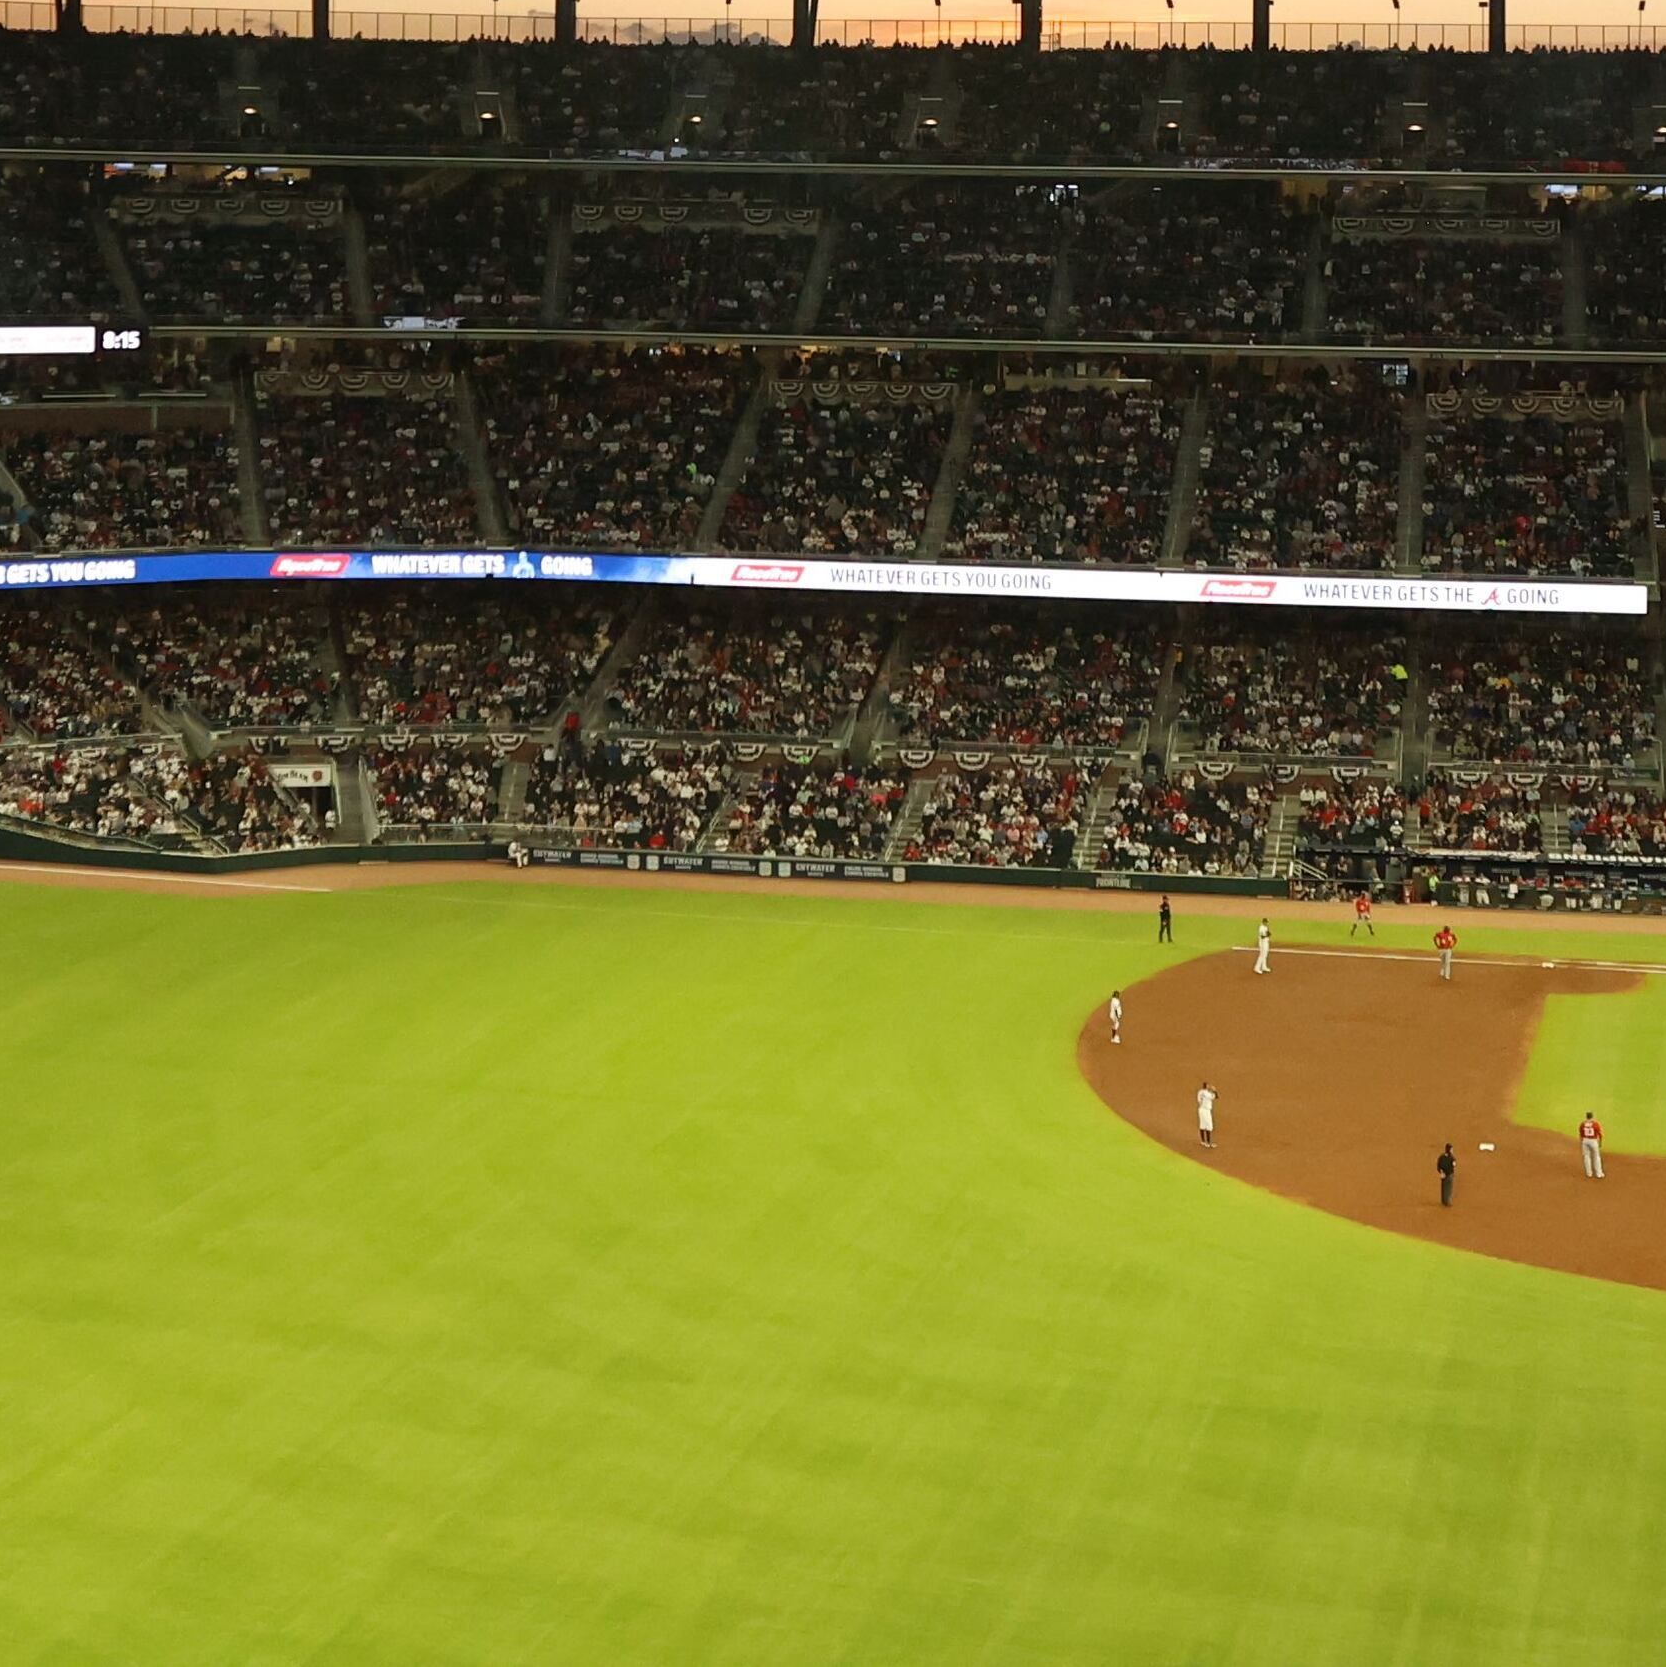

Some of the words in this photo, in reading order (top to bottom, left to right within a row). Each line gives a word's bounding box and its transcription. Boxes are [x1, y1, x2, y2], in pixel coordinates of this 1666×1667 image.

[102, 330, 141, 350] 8:15
[6, 563, 49, 585] GETS
[50, 562, 84, 582] YOU
[84, 559, 136, 581] GOING
[371, 554, 461, 575] WHATEVER
[462, 555, 505, 575] GETS
[541, 555, 593, 576] GOING
[830, 567, 918, 587] WHATEVER
[921, 570, 961, 587] GETS
[965, 572, 997, 589] YOU
[1001, 573, 1052, 591] GOING
[1303, 583, 1393, 601] WHATEVER
[1397, 585, 1440, 603] GETS
[1445, 587, 1475, 604] THE
[1507, 589, 1560, 606] GOING
